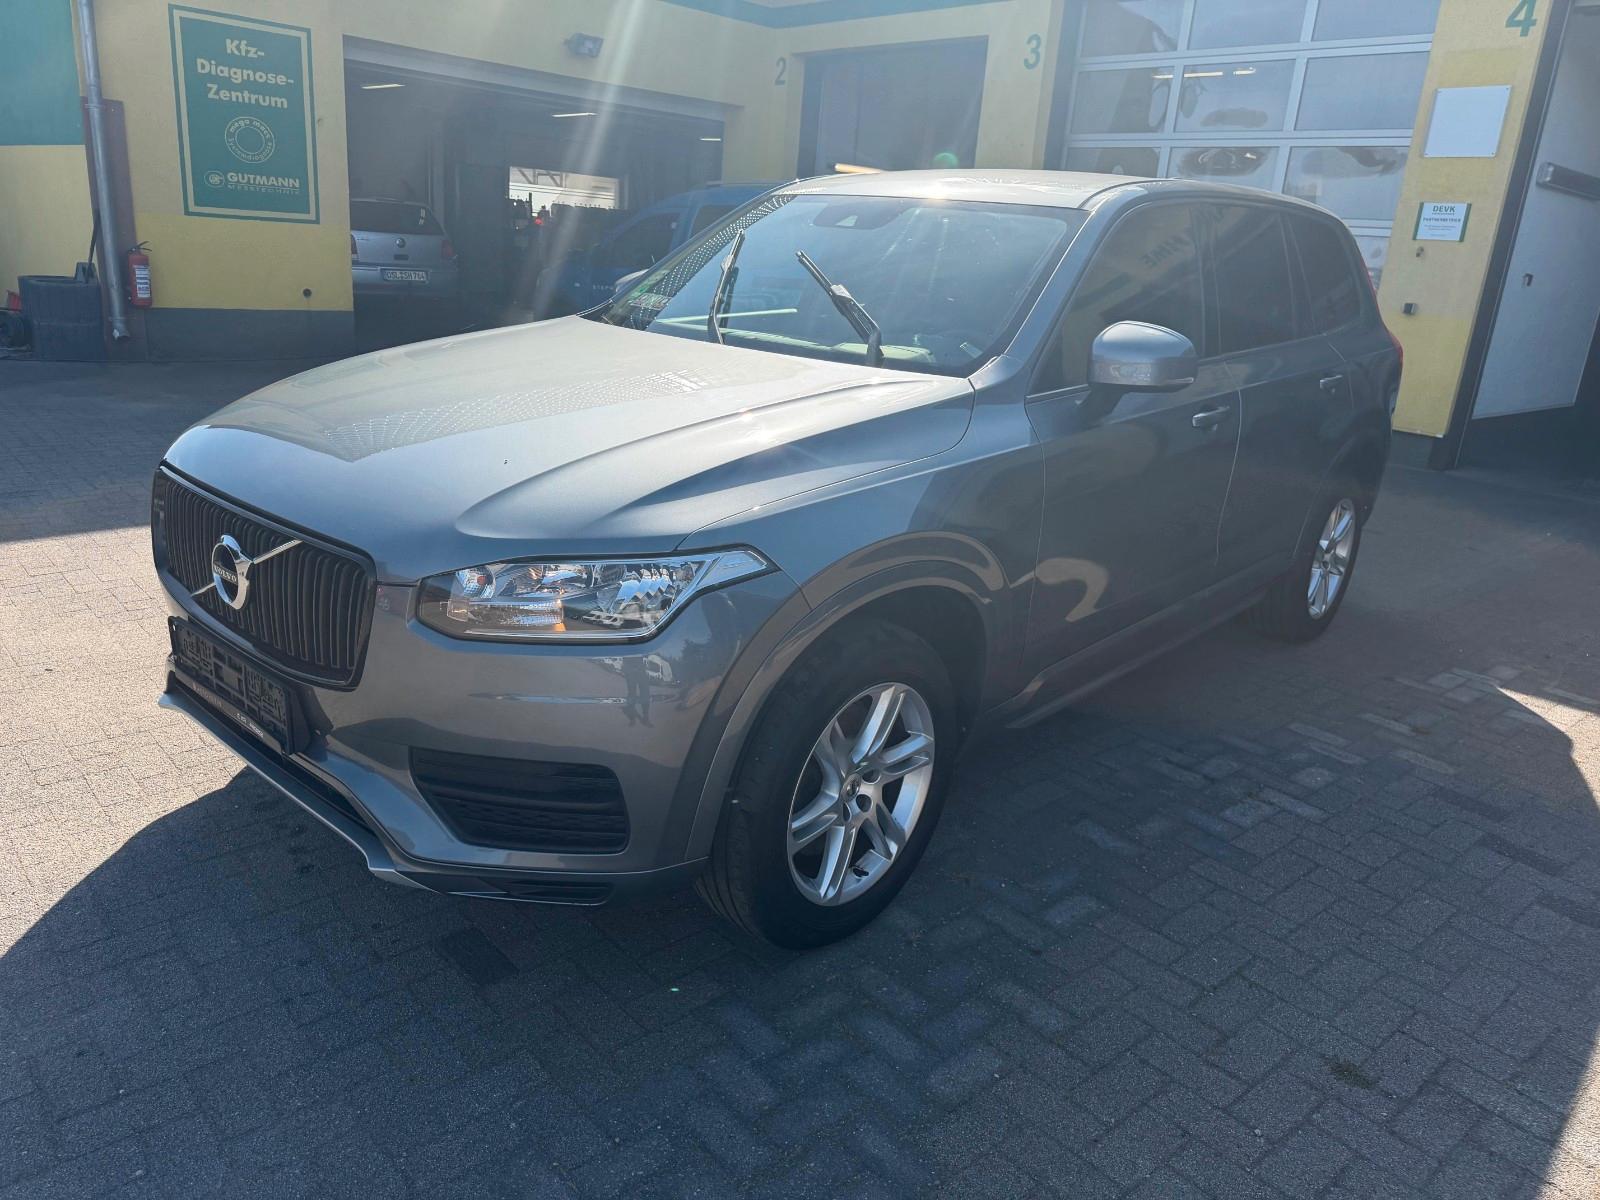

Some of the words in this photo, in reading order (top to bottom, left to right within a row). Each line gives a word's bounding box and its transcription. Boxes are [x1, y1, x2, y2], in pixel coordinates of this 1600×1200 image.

[1504, 0, 1538, 37] 4
[225, 38, 265, 58] Kfz-
[1023, 33, 1042, 70] 3
[196, 58, 294, 85] Diagnose-
[774, 56, 787, 86] 2
[206, 83, 288, 109] Zentrum
[227, 172, 300, 188] GUTMANN
[1432, 205, 1456, 213] DEVK
